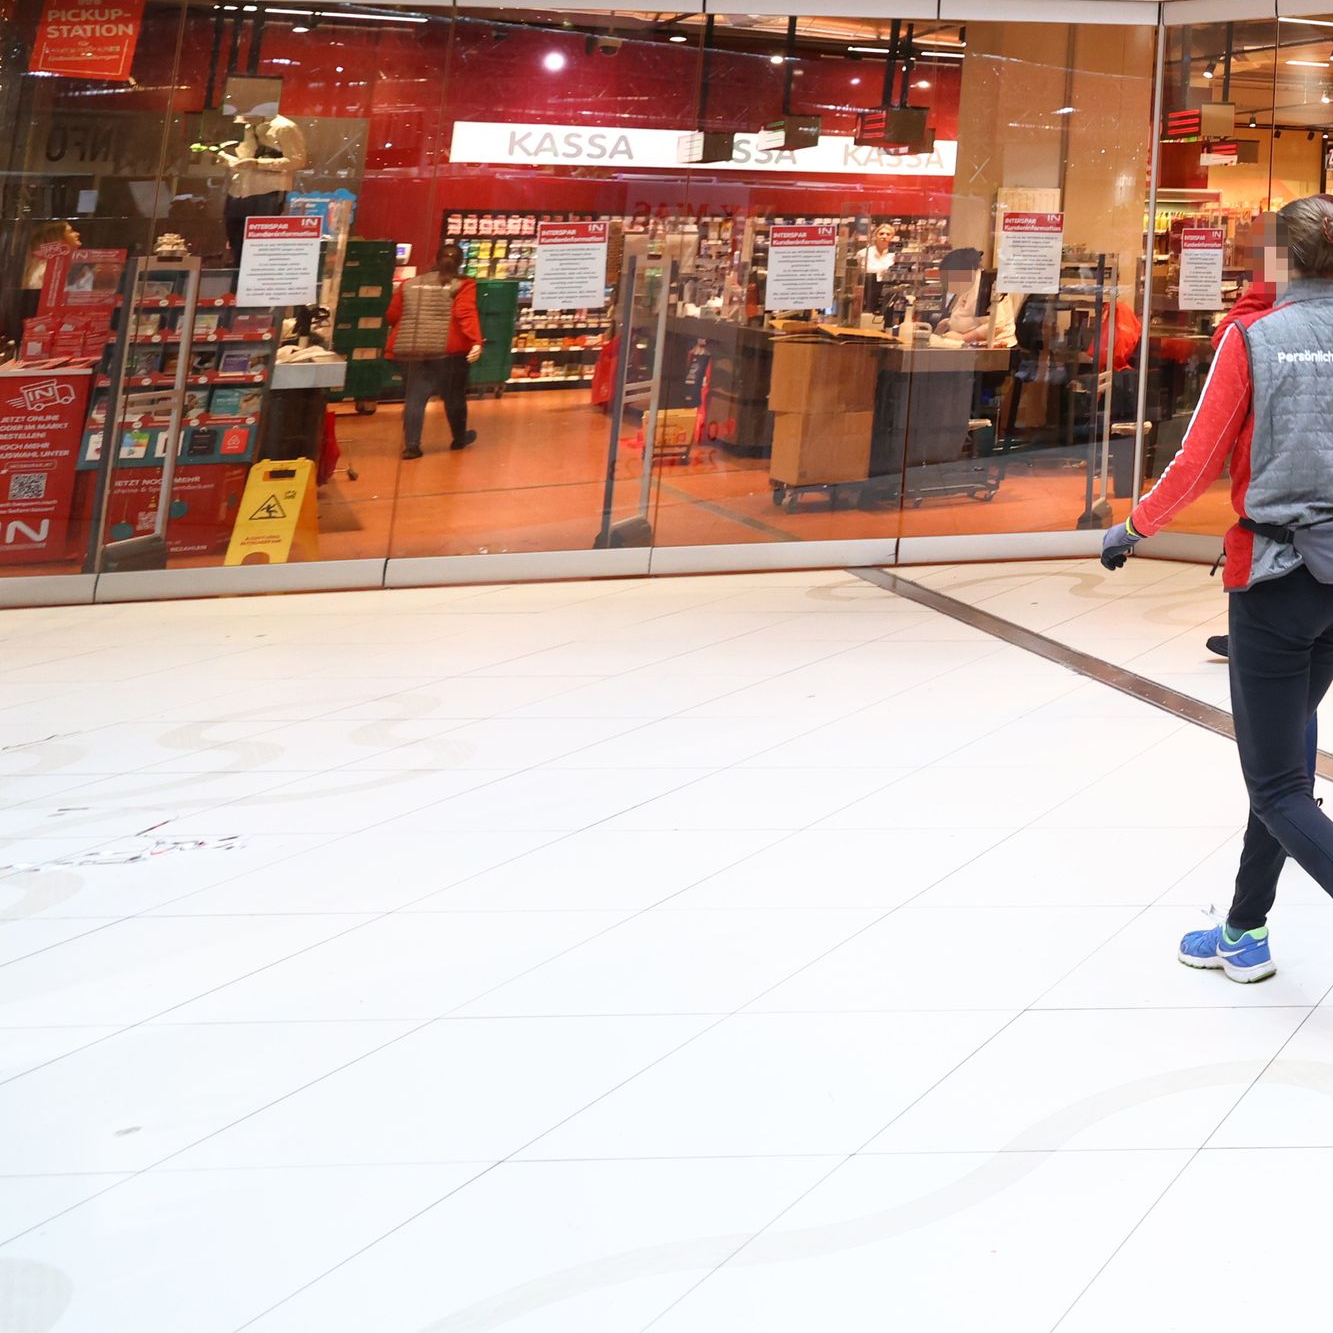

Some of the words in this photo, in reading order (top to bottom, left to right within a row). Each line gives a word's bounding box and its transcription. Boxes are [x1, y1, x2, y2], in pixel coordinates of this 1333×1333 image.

[46, 24, 134, 38] STATION
[508, 130, 634, 160] KASSA
[301, 218, 319, 226] IN
[28, 387, 54, 401] IN
[174, 476, 201, 485] MEHR
